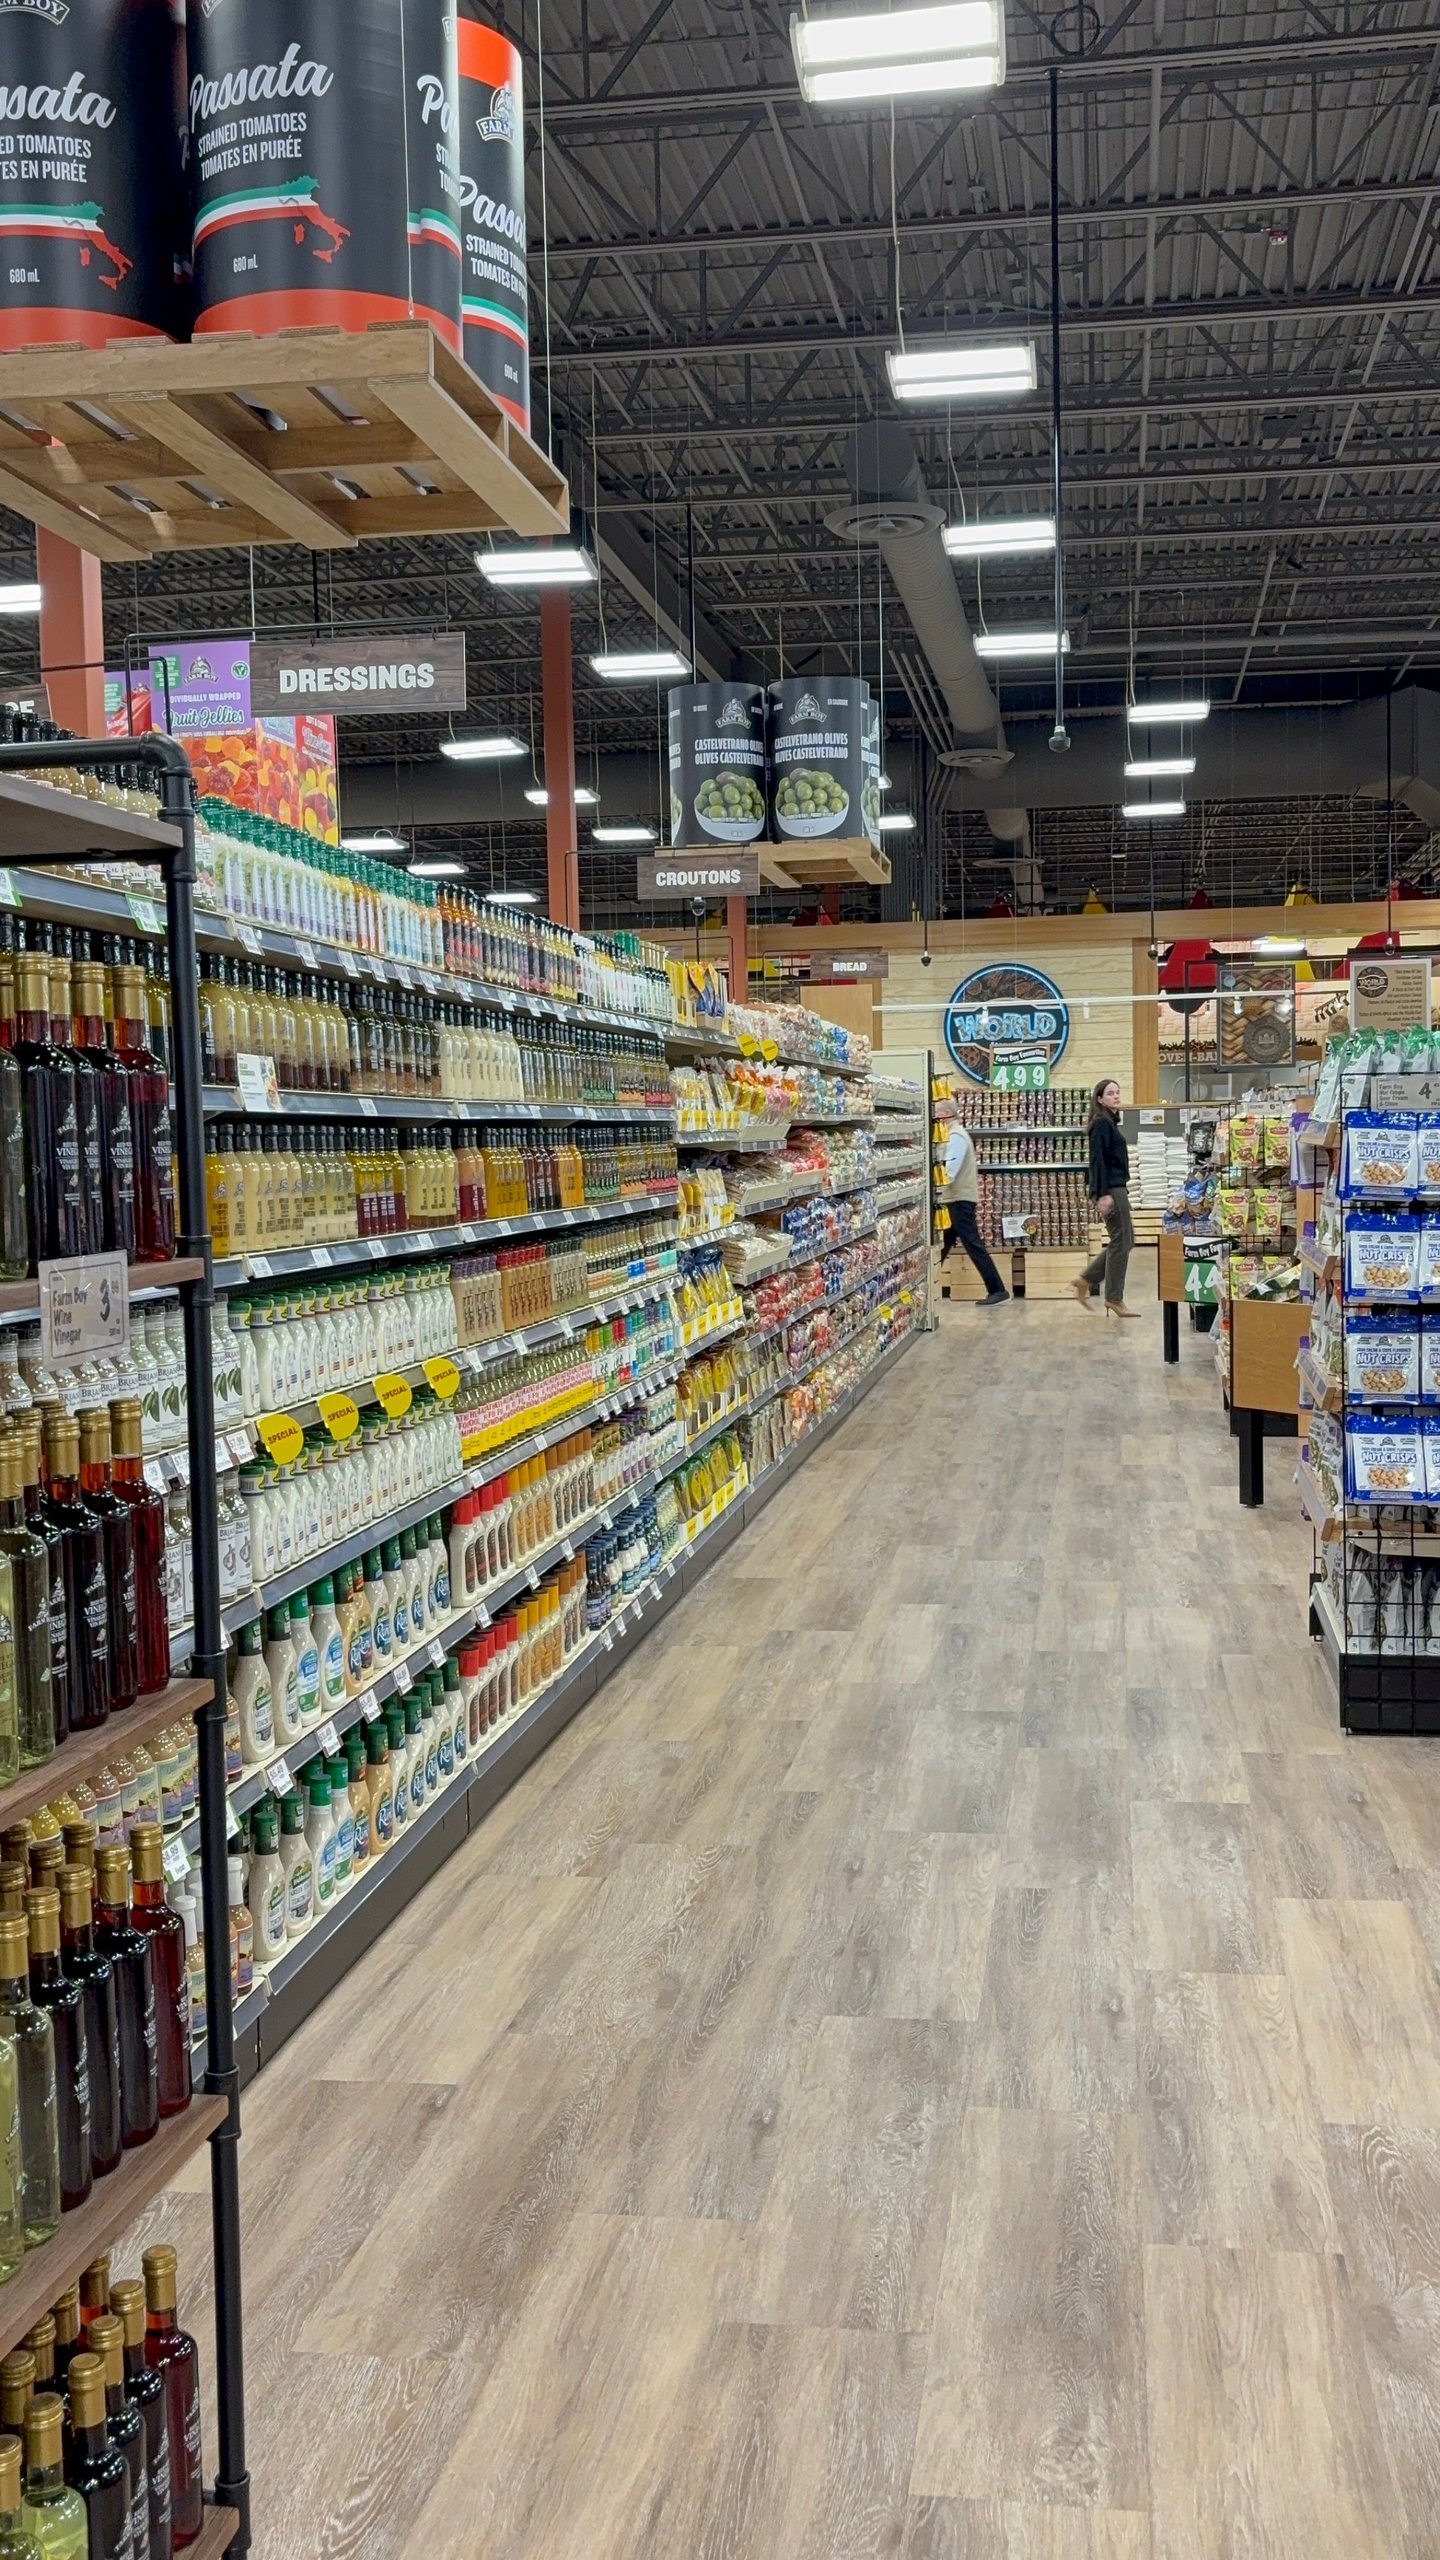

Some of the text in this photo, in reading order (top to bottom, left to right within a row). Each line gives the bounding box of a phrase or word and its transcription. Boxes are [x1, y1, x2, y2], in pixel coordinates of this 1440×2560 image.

[189, 42, 334, 134] Passata
[198, 112, 307, 158] STRAINED TOMATOES
[17, 134, 92, 159] TOMATOES
[201, 135, 302, 182] TOMATES EN PURÉE
[21, 160, 39, 179] EN
[42, 160, 87, 183] PURÉE
[466, 233, 509, 266] STRAINED
[233, 254, 258, 273] 680 mL
[470, 257, 511, 288] TOMATES
[9, 268, 40, 283] 680 mL
[279, 663, 435, 694] DRESSINGS
[200, 705, 244, 728] Jellies
[694, 738, 749, 751] CASTELVETRANO
[774, 732, 848, 750] CASTELVETRANO OLIVES
[694, 752, 719, 765] OLIVES
[792, 747, 849, 760] CASTELVETRANO
[655, 868, 741, 887] CROUTONS
[832, 962, 868, 973] BREAD
[954, 1011, 1057, 1042] WORLD
[992, 1065, 1046, 1091] 4.99
[1418, 1082, 1432, 1100] 4
[1360, 1249, 1414, 1262] NUT CRISPS
[53, 1291, 73, 1307] Farm
[53, 1309, 72, 1326] Wine
[54, 1328, 82, 1346] Vinegar
[1356, 1353, 1412, 1365] NUT CRISPS
[432, 1367, 457, 1383] SPECIAL
[381, 1385, 408, 1401] SPECIAL
[327, 1406, 355, 1422] SPECIAL
[267, 1427, 299, 1445] SPECIAL
[1361, 1451, 1417, 1464] NUT CRISPS
